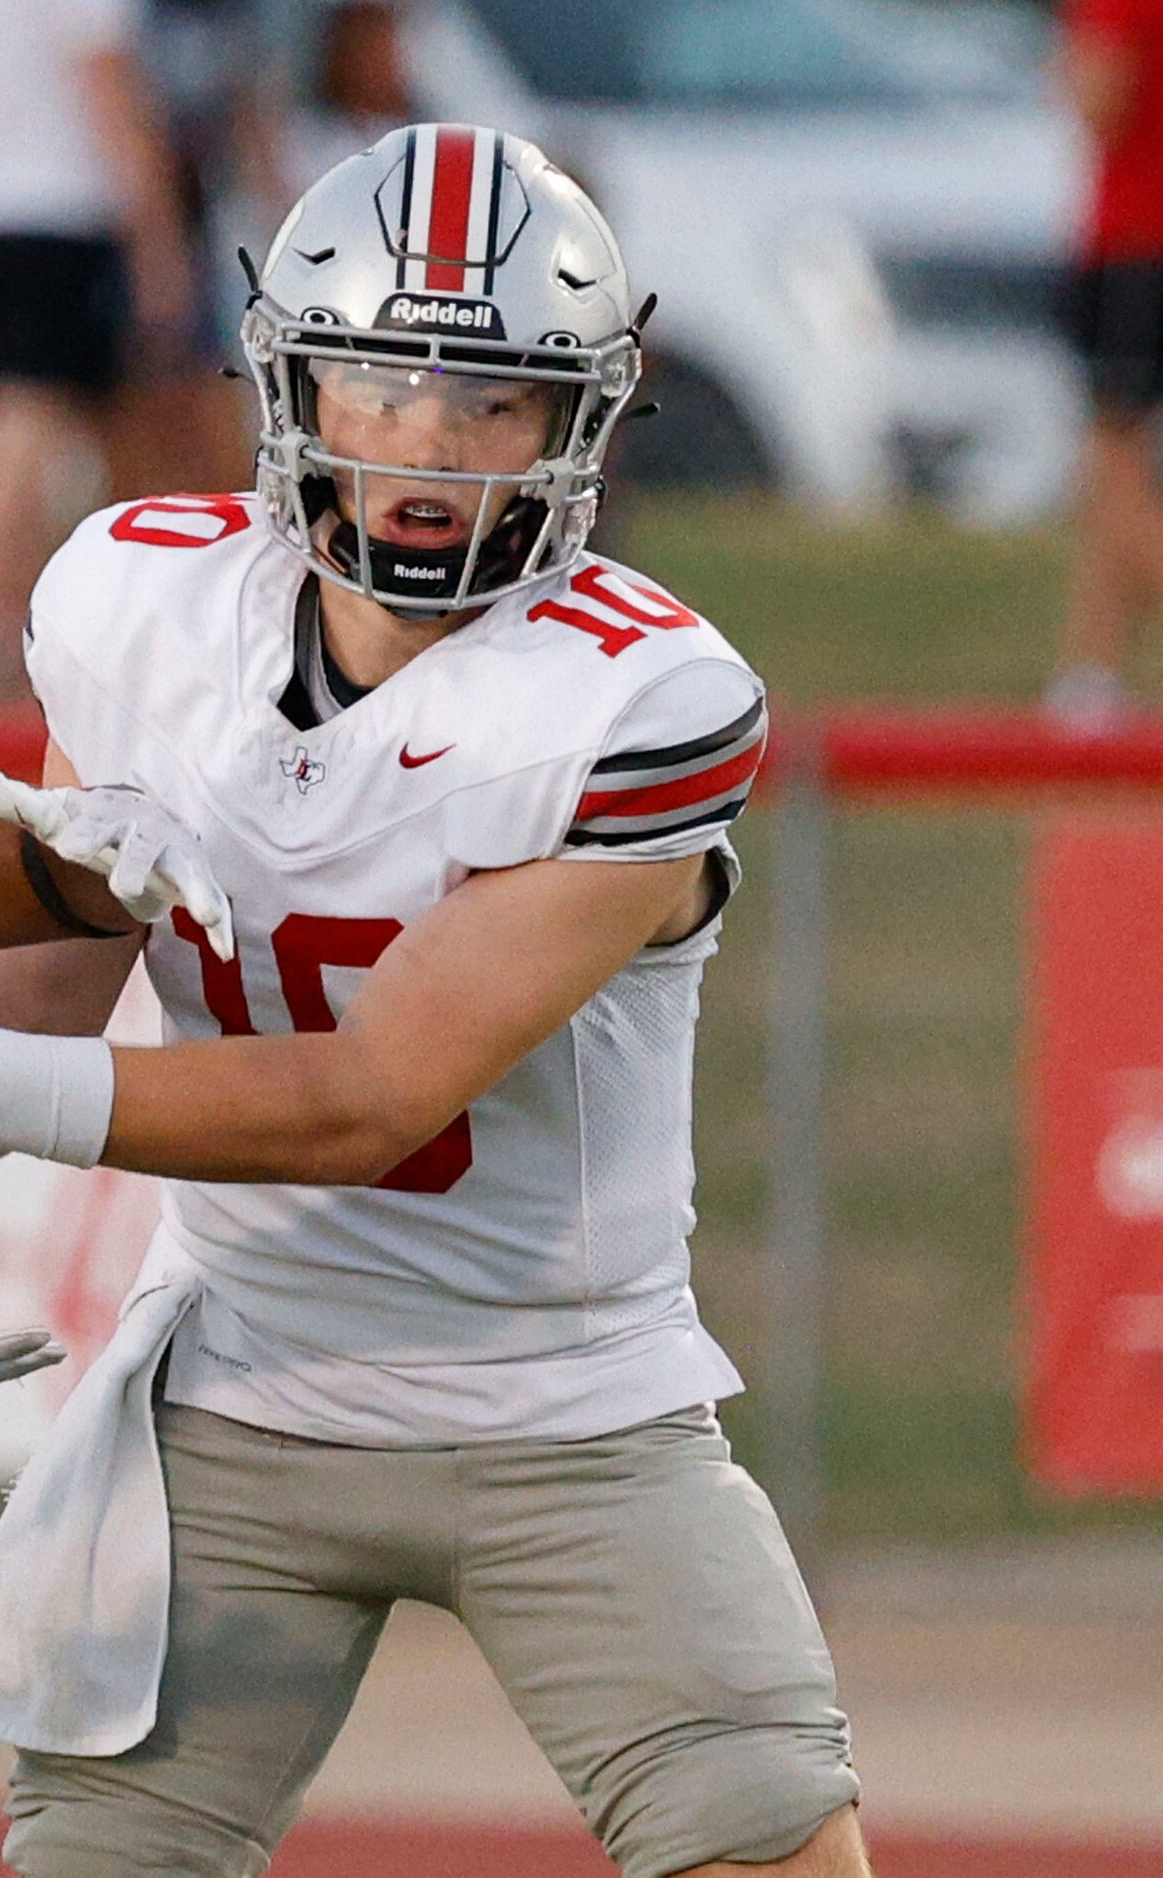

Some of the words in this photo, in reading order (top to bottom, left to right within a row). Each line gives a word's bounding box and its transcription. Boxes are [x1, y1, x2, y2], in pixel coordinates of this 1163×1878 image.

[390, 297, 493, 329] Riddell
[393, 563, 446, 580] Riddell
[526, 563, 700, 659] 10
